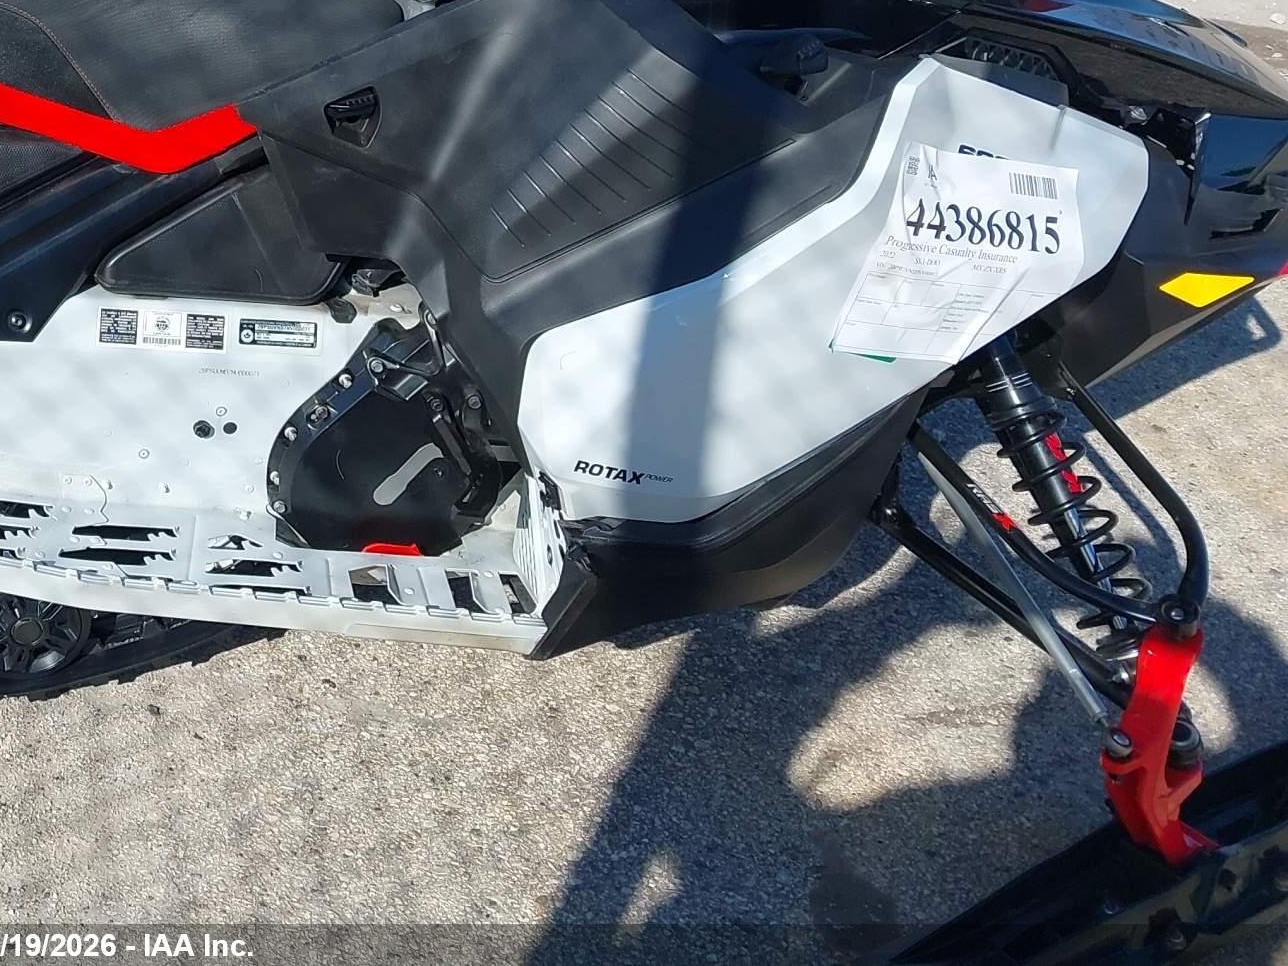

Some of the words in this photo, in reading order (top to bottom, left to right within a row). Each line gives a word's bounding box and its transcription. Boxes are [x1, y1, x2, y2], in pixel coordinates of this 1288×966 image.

[906, 198, 1061, 255] 44386815
[885, 235, 938, 254] Progressive
[938, 244, 977, 261] Casualty
[978, 249, 1018, 264] Insurance
[574, 460, 645, 485] ROTAX
